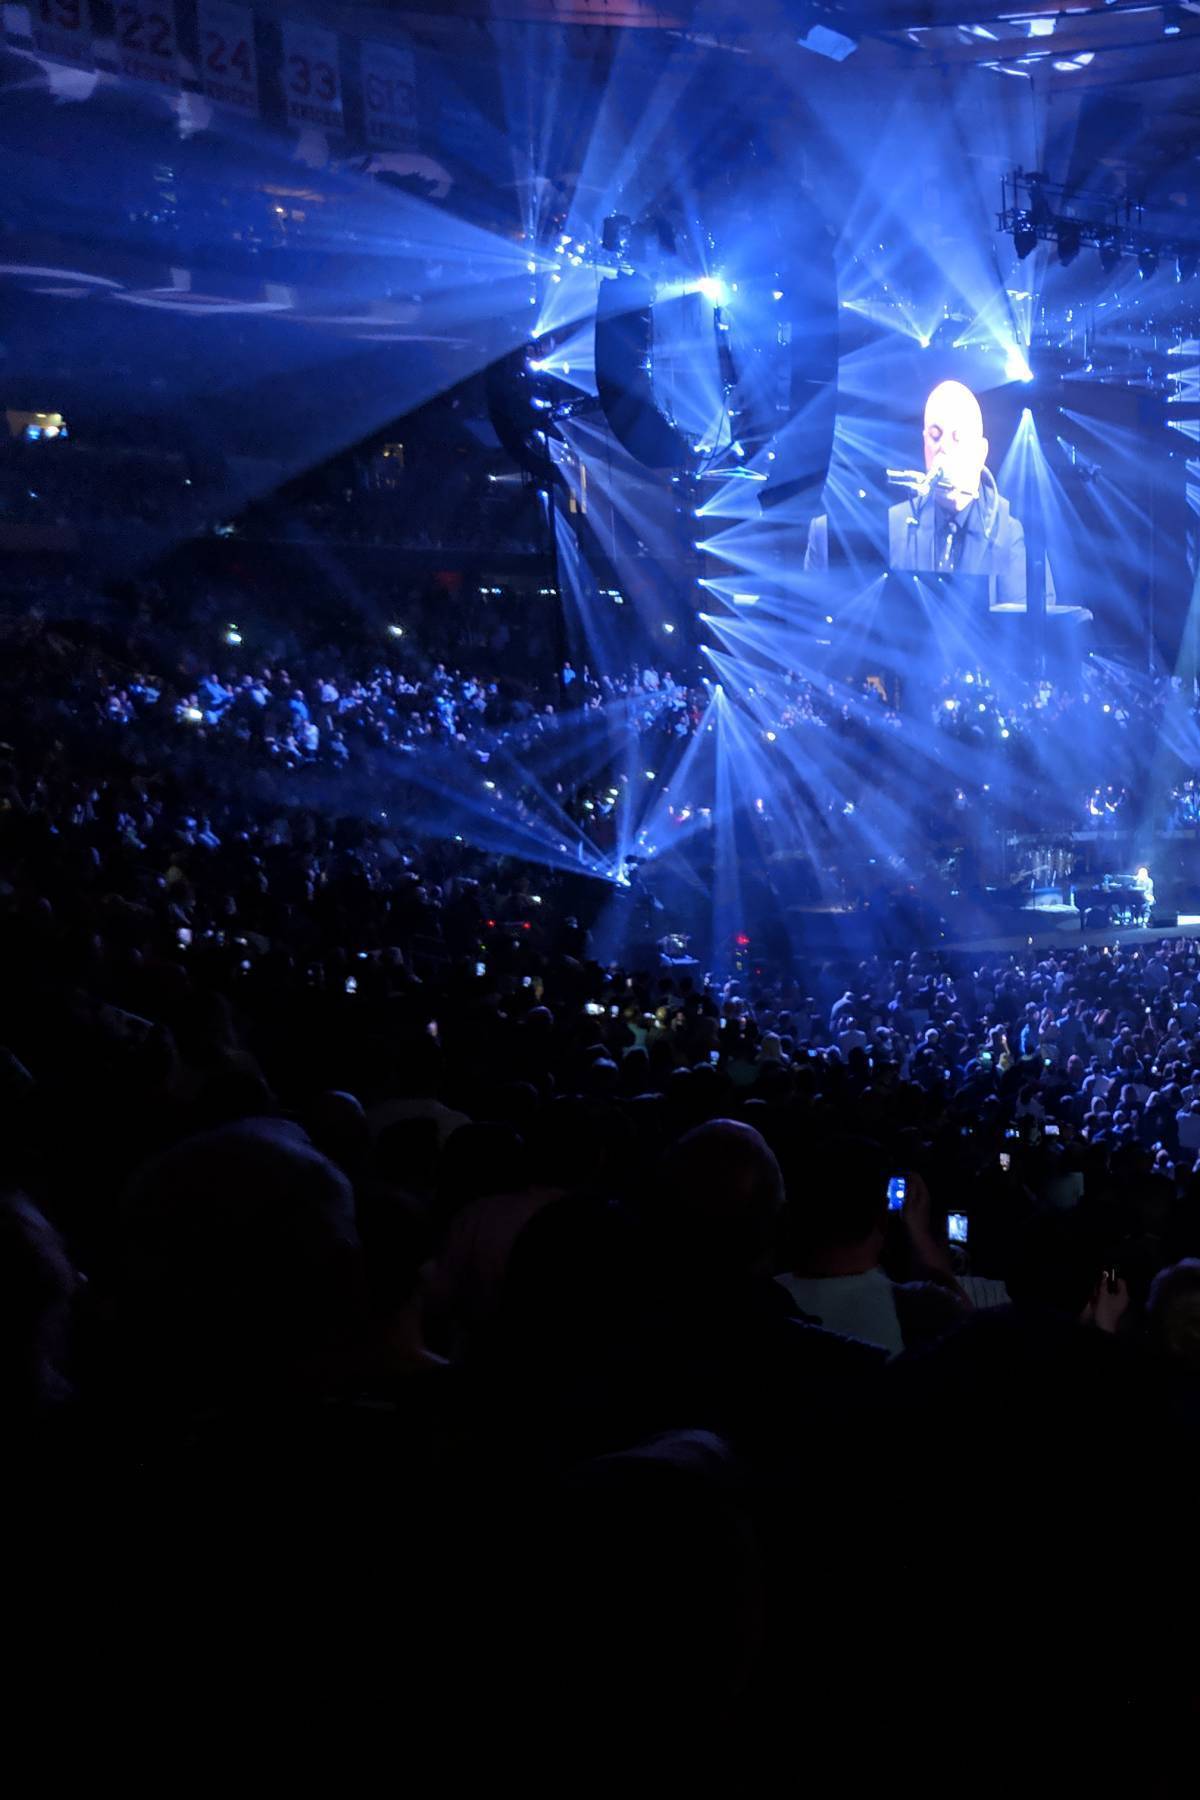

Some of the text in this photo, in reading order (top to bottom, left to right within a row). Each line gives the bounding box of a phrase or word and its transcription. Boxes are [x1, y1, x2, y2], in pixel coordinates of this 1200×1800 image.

[120, 5, 173, 57] 22
[206, 31, 252, 82] 24
[289, 54, 338, 101] 33
